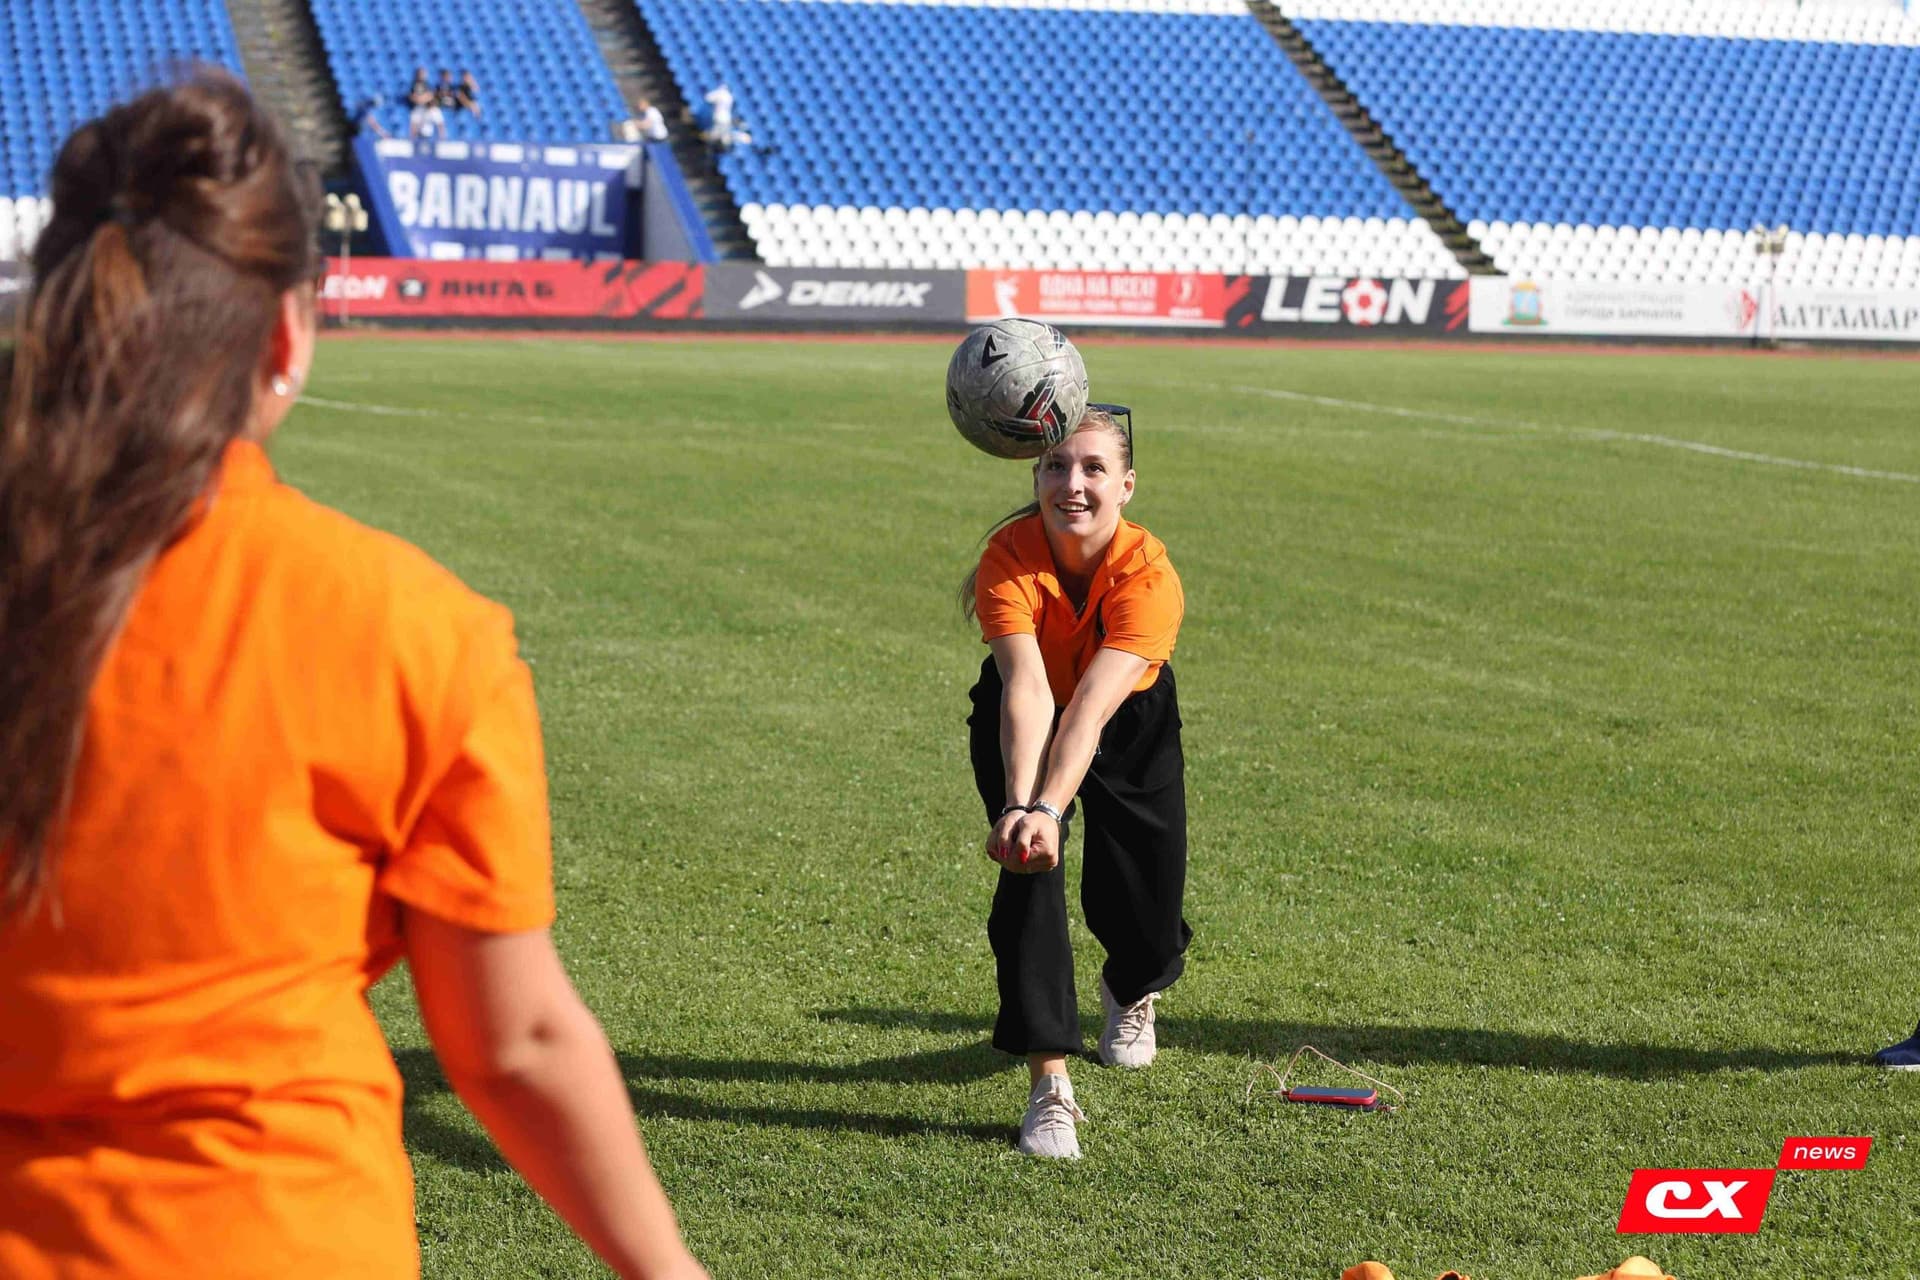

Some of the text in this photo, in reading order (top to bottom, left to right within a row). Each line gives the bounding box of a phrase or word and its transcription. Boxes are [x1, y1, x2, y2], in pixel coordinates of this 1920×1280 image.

[387, 170, 618, 236] BARNAUL
[317, 275, 388, 299] EON
[786, 281, 932, 308] DEMIX
[1261, 275, 1436, 325] LEON
